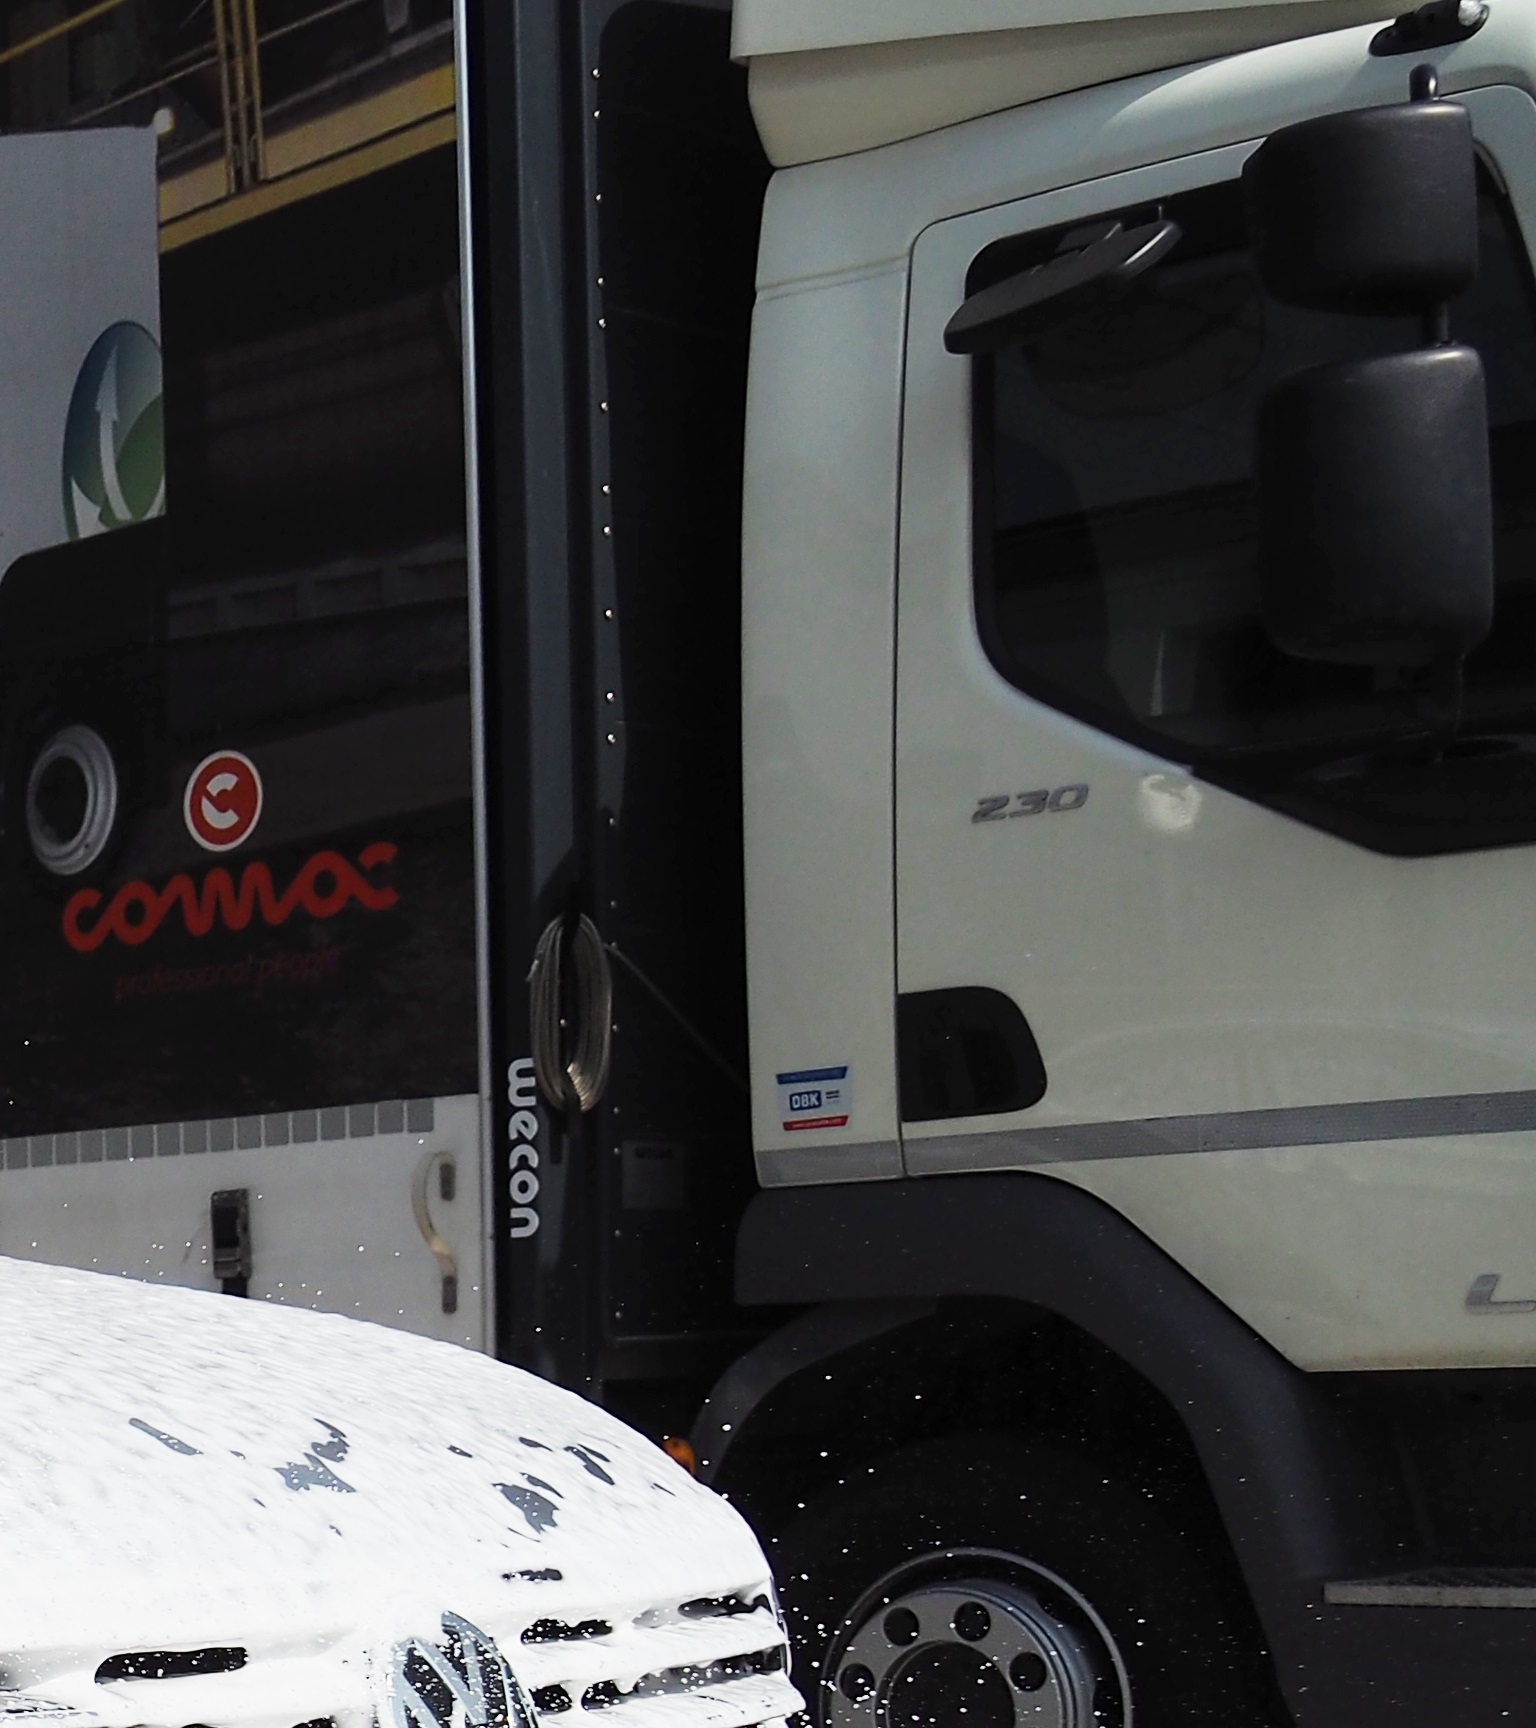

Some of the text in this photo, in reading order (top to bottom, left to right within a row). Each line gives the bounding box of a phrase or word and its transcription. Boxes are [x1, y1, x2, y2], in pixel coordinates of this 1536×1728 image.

[971, 783, 1090, 824] 230
[61, 841, 400, 952] comac
[507, 1057, 540, 1239] wecon
